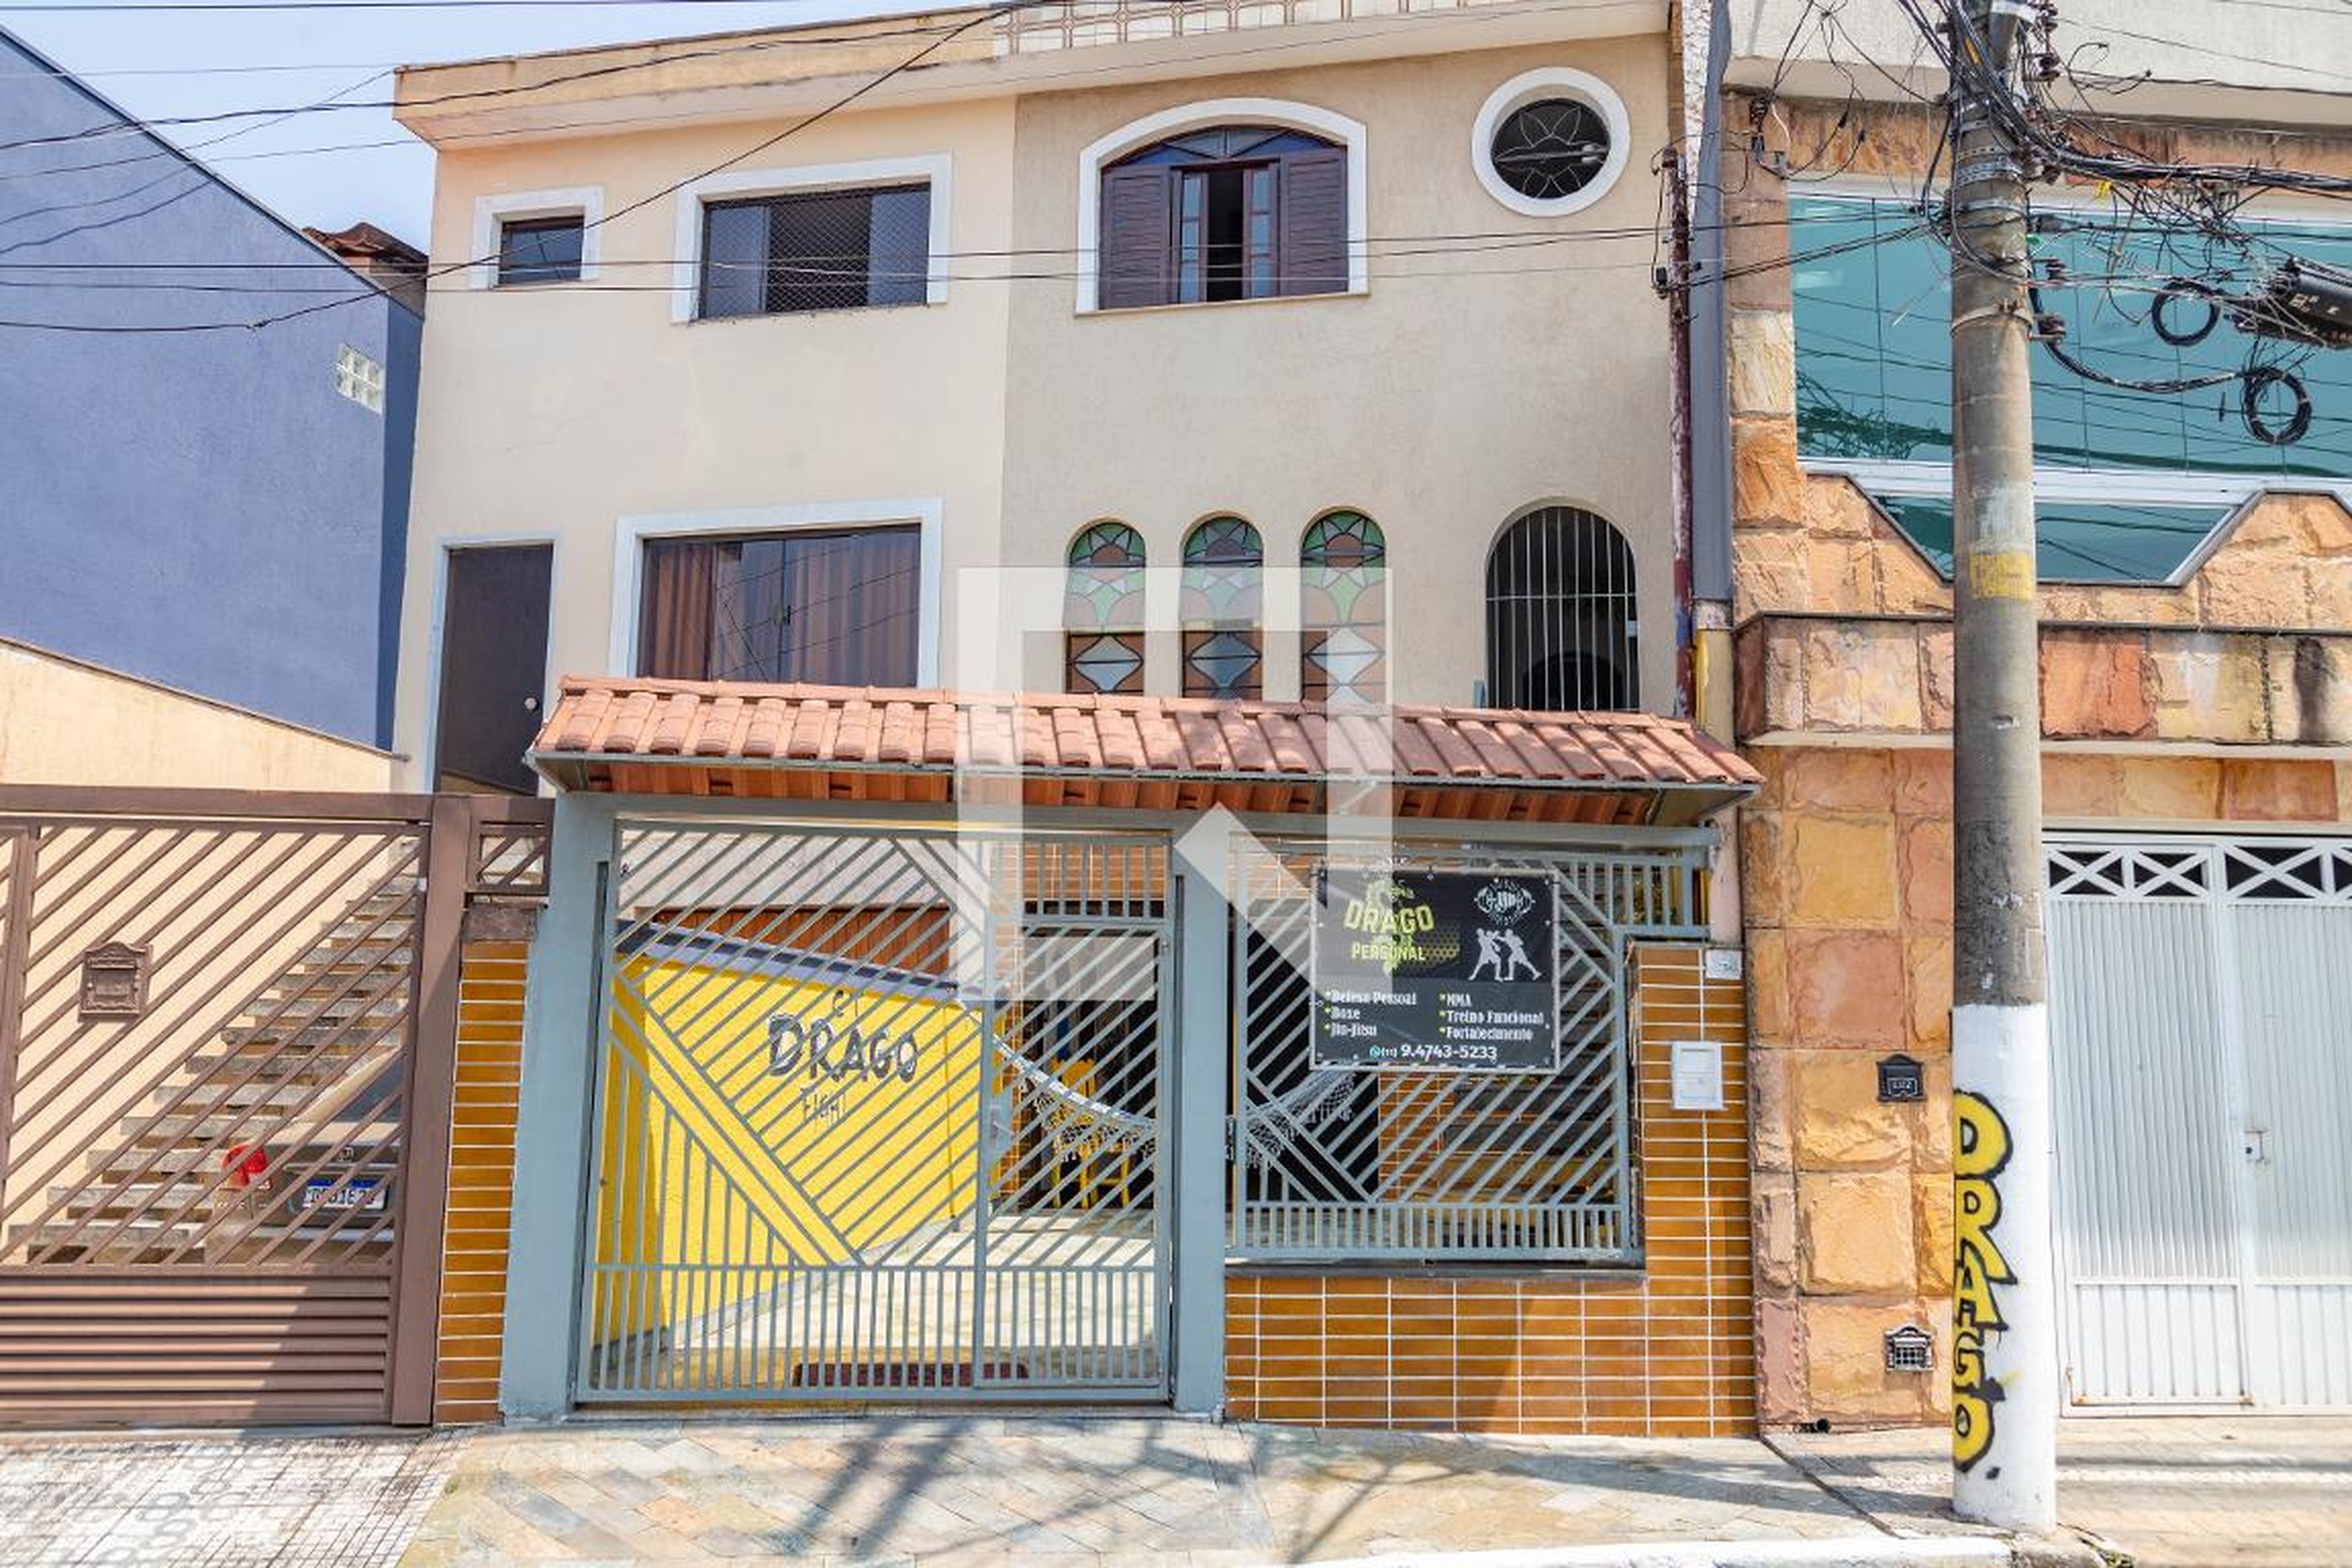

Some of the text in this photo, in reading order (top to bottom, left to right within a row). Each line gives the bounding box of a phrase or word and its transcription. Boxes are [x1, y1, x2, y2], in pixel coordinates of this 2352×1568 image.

[1344, 899, 1434, 933] DRAGO
[1352, 942, 1426, 962] PERSONAL
[1373, 992, 1417, 1005] Pessoal
[1447, 993, 1472, 1006] MMA
[1331, 1006, 1360, 1019] Boxe
[1447, 1011, 1544, 1024] Treino Funcional
[1446, 1027, 1534, 1040] Fortalecimento
[768, 1012, 918, 1082] DRAGO
[1401, 1043, 1497, 1061] 9.4743-5233
[1953, 1088, 2018, 1473] DRAGO
